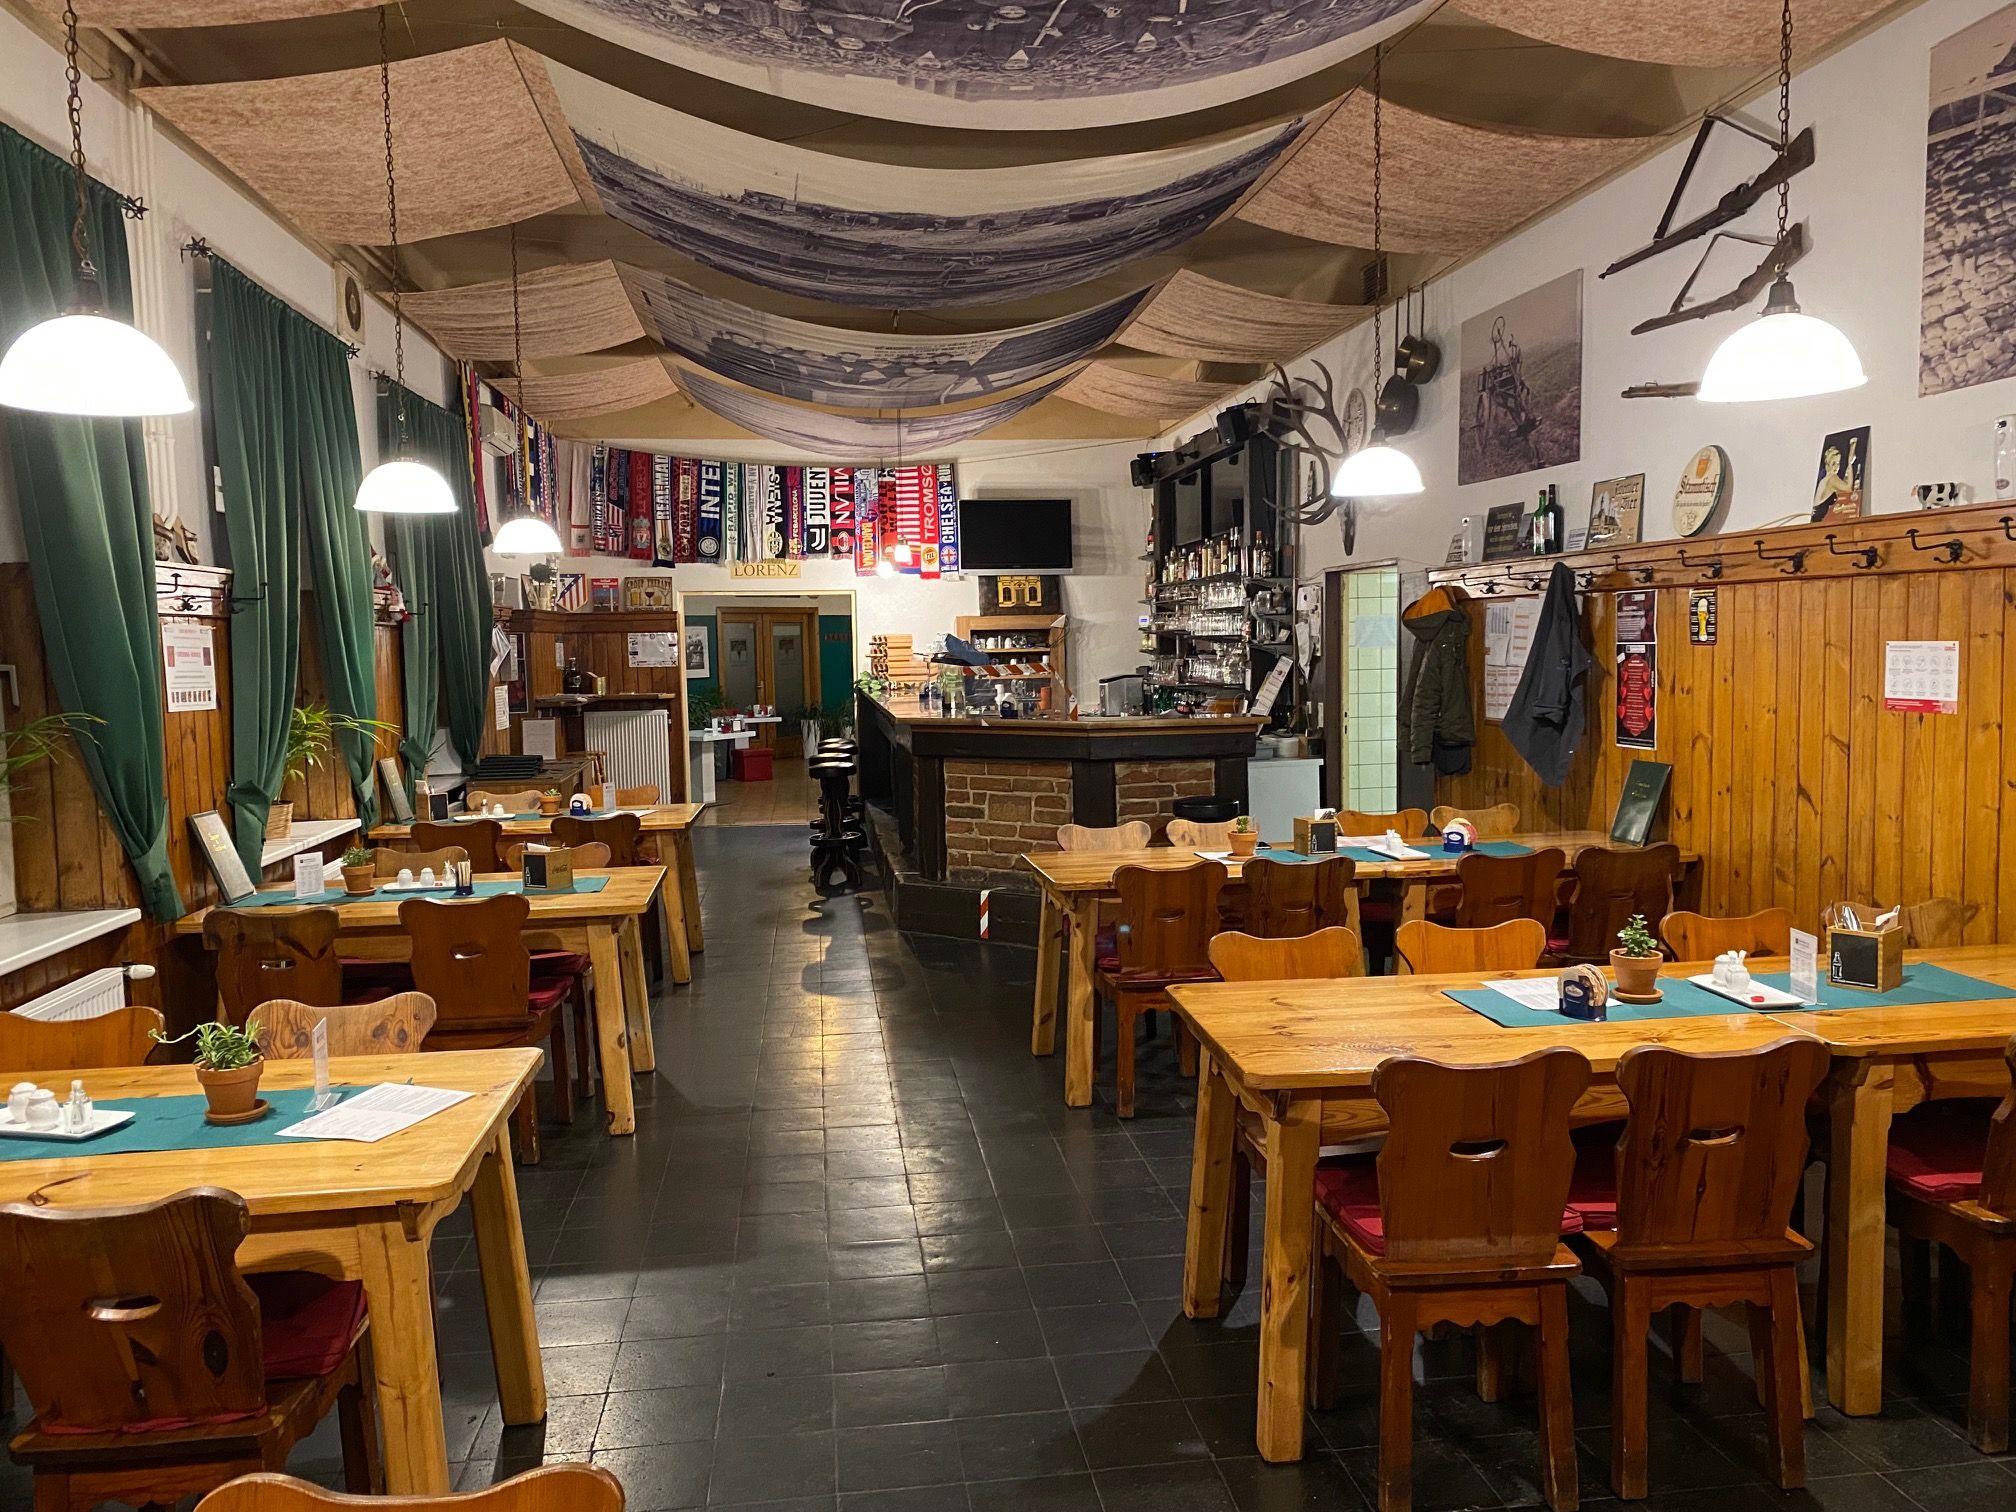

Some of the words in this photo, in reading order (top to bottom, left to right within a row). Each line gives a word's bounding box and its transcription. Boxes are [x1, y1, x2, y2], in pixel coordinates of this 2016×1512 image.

[656, 488, 669, 520] REAL
[765, 474, 783, 525] SIENA
[834, 468, 850, 524] MILAN
[920, 465, 935, 540] TROMSØ
[940, 487, 954, 543] CHELSEA
[861, 523, 874, 566] BARCELONA
[734, 564, 798, 577] LORENZ
